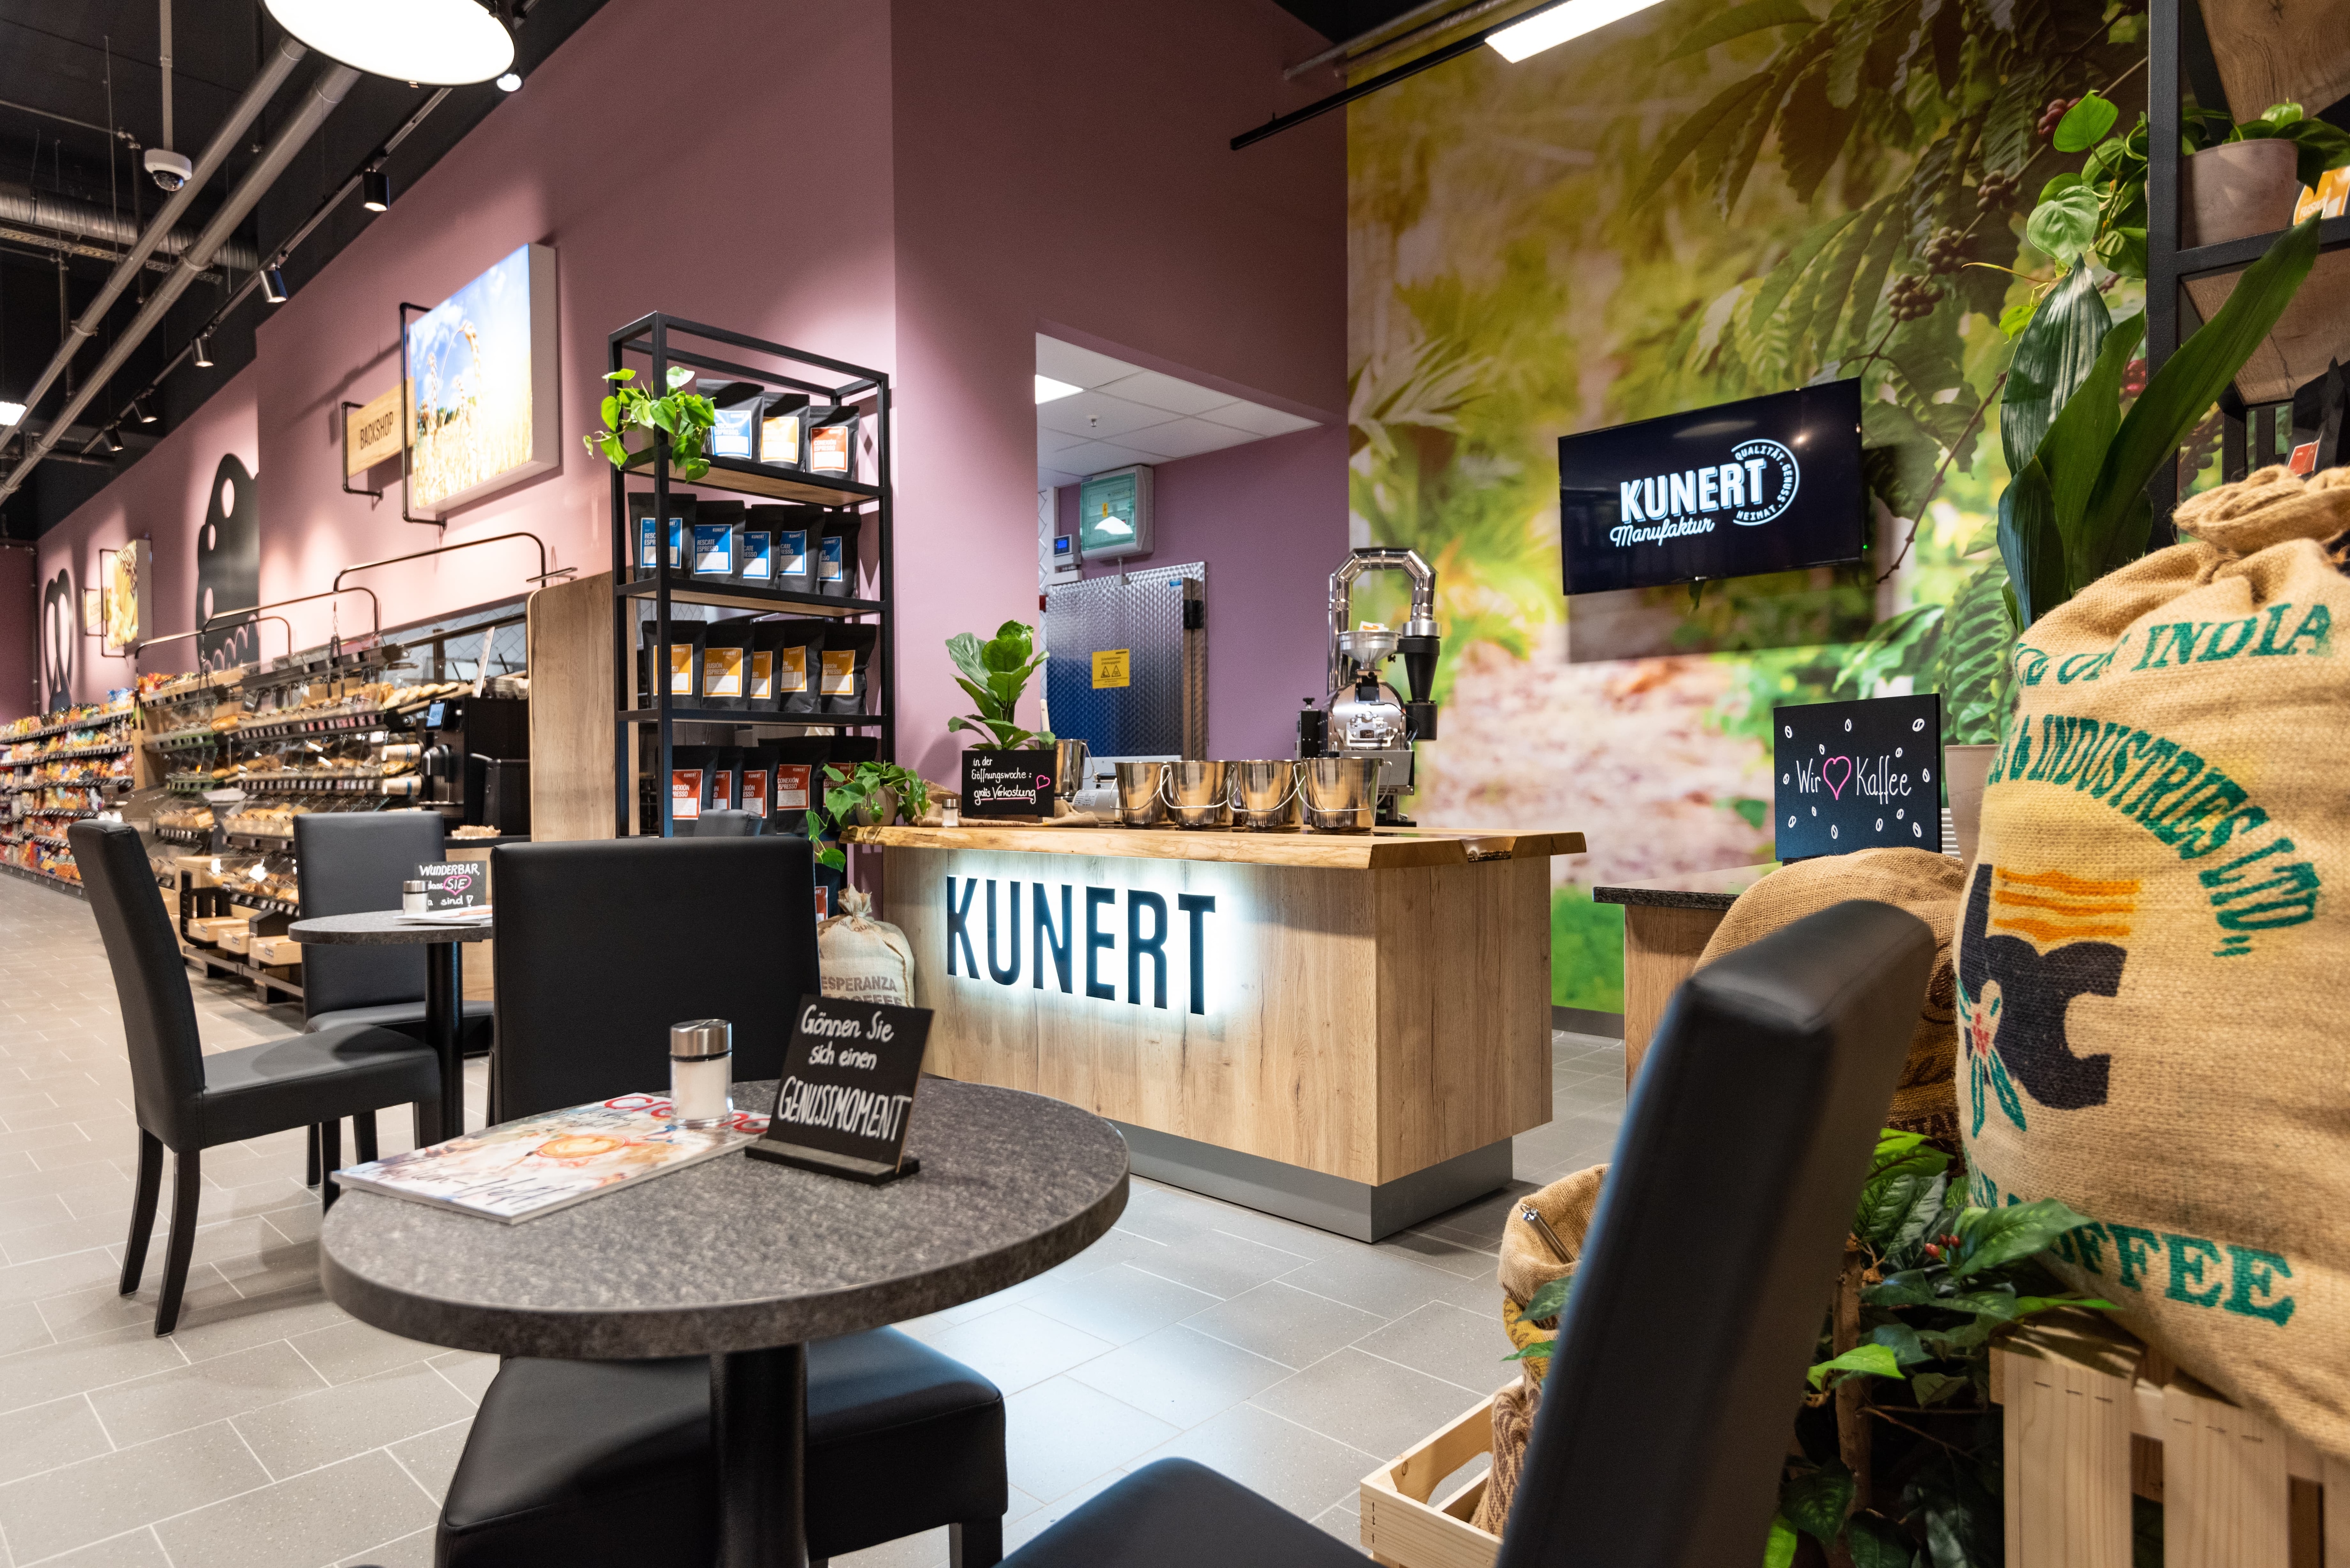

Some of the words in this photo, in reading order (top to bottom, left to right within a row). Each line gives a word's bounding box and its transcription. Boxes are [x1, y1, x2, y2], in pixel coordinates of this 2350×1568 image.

[360, 411, 393, 450] BACKSHOP
[1620, 457, 1767, 525] KUNERT
[1610, 517, 1716, 547] Manufaktur
[1736, 504, 1777, 521] HEIMAT
[2131, 603, 2334, 672] INDIA
[973, 758, 980, 766] in
[982, 756, 993, 766] der
[1795, 758, 1821, 793] Wir
[1856, 754, 1911, 805] Kaffee
[974, 787, 991, 805] gratis
[992, 784, 1036, 805] Verkostung
[2027, 714, 2270, 860] INDUSTRIES
[446, 878, 468, 890] SIE
[947, 875, 1216, 1015] KUNERT
[821, 975, 898, 993] ESPERANZA
[800, 1004, 862, 1038] Gönnen
[866, 1011, 894, 1043] Sie
[808, 1041, 834, 1066] sich
[838, 1048, 877, 1071] einen
[777, 1075, 913, 1142] GENUSSMOMENT
